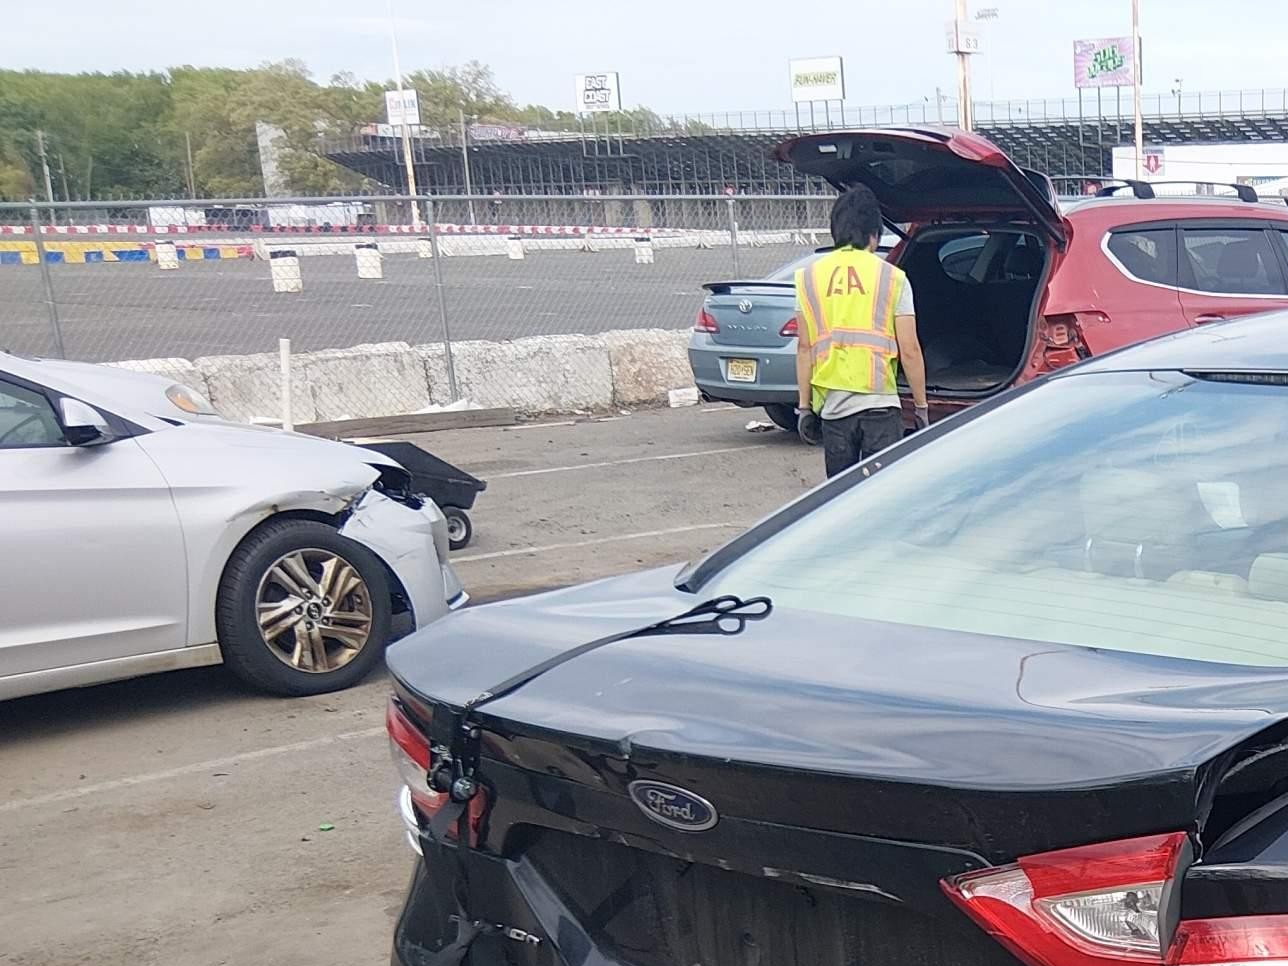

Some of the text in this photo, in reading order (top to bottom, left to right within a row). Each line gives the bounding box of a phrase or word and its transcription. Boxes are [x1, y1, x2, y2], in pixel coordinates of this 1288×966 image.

[584, 75, 607, 90] EAST
[583, 89, 611, 104] COAST
[647, 789, 697, 821] Ford
